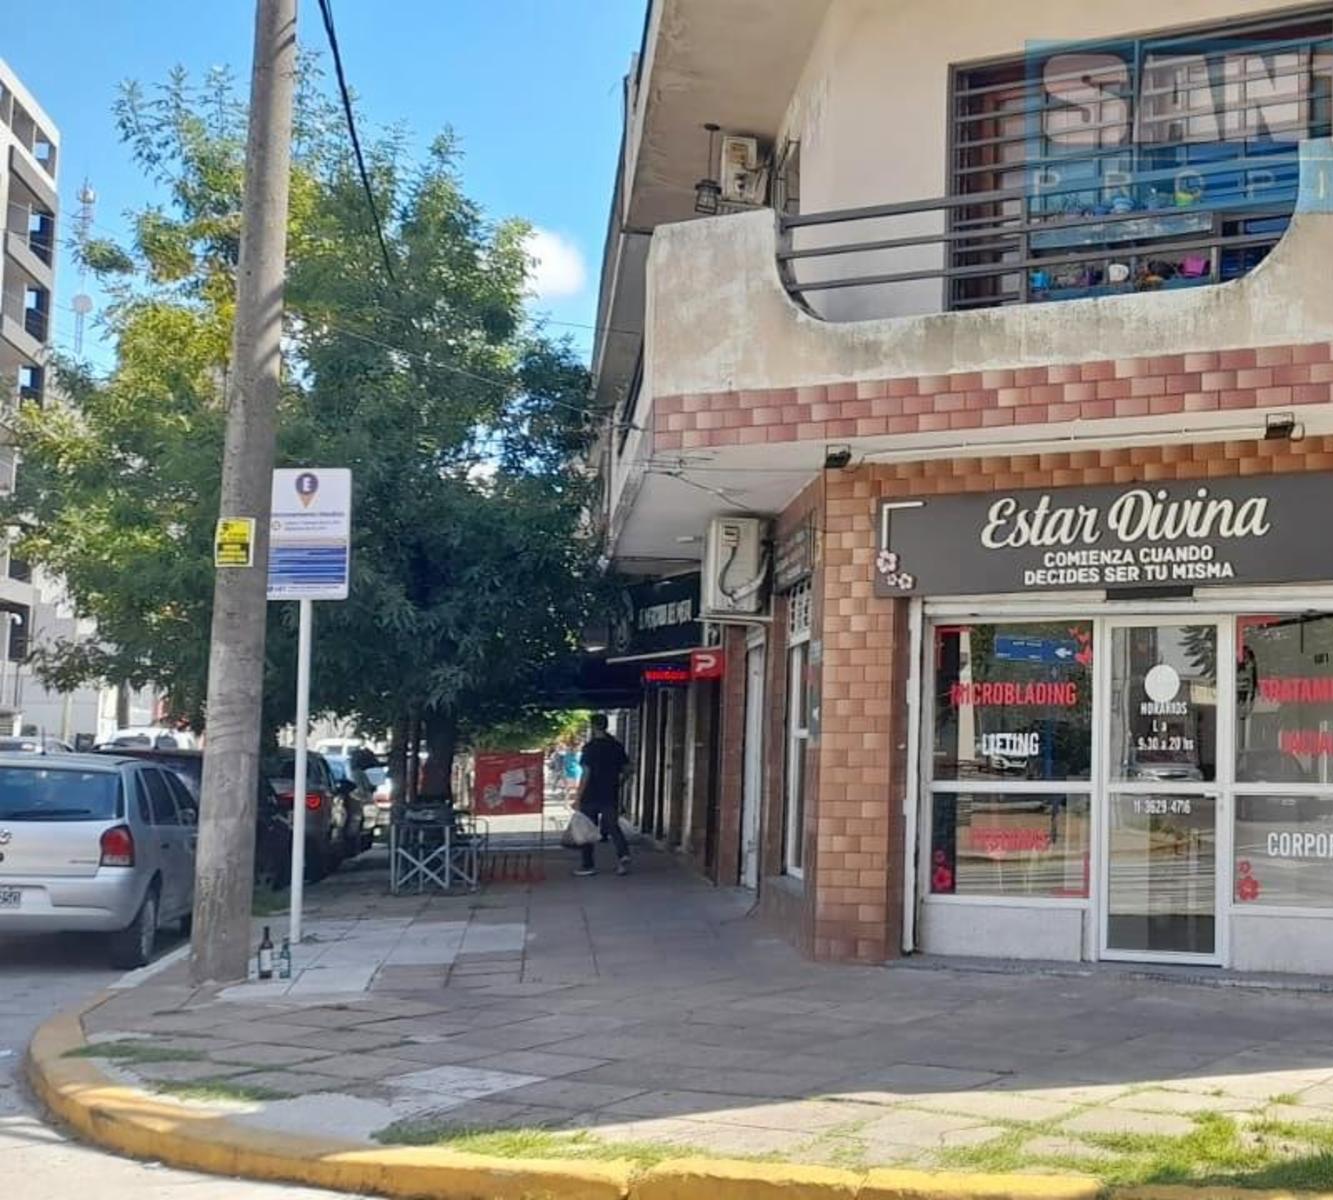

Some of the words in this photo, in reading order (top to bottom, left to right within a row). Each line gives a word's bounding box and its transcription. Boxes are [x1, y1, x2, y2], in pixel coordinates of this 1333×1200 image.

[302, 476, 312, 492] E
[981, 494, 1101, 549] Estar
[1108, 487, 1271, 543] Divina
[1043, 548, 1134, 568] COMIENZA
[1138, 544, 1214, 563] CUANDO
[1024, 566, 1100, 585] DECIDES
[1104, 565, 1140, 582] SER
[1145, 564, 1168, 581] TU
[1172, 561, 1234, 580] MISMA
[951, 680, 1078, 706] MICROBLADING
[1140, 701, 1188, 716] HORARIOS
[982, 732, 1040, 756] LIFTING
[1168, 736, 1181, 750] 20
